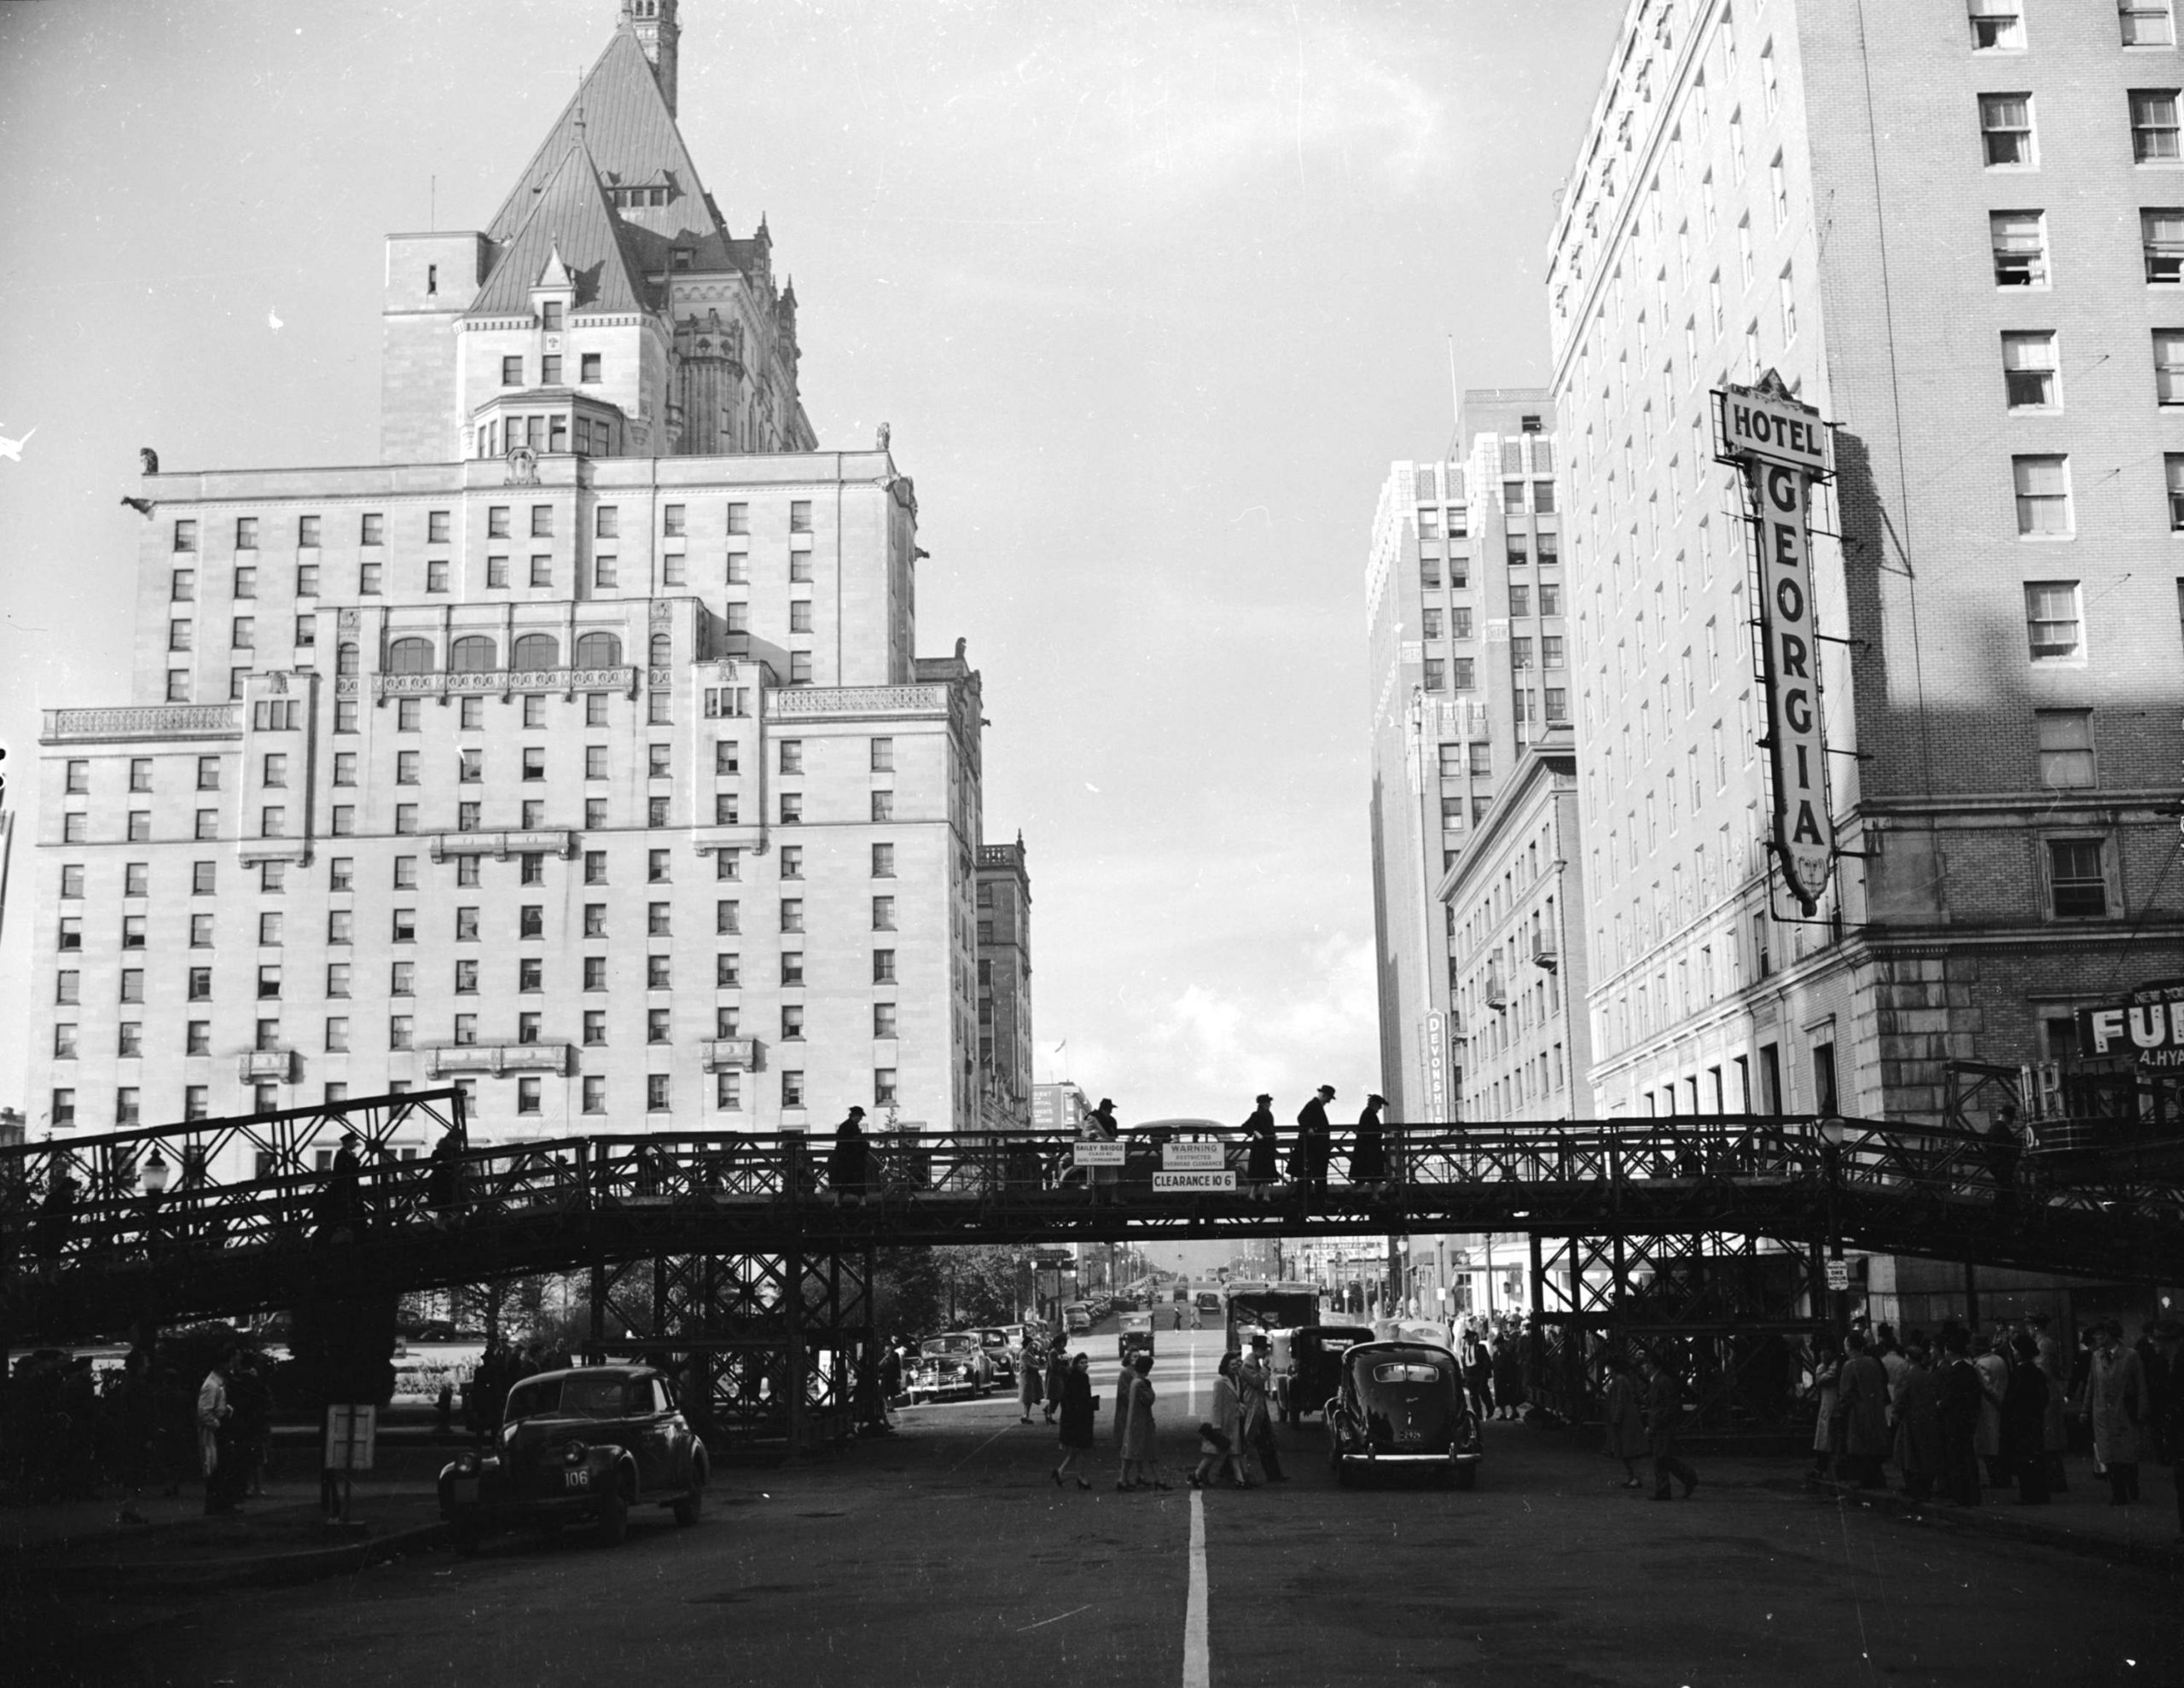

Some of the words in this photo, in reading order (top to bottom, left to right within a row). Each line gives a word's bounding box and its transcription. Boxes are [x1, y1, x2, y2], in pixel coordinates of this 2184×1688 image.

[1734, 403, 1822, 457] HOTEL
[1768, 467, 1825, 846] GEORGIA
[1154, 1175, 1211, 1186] CLEARANCE
[565, 1470, 588, 1488] 106
